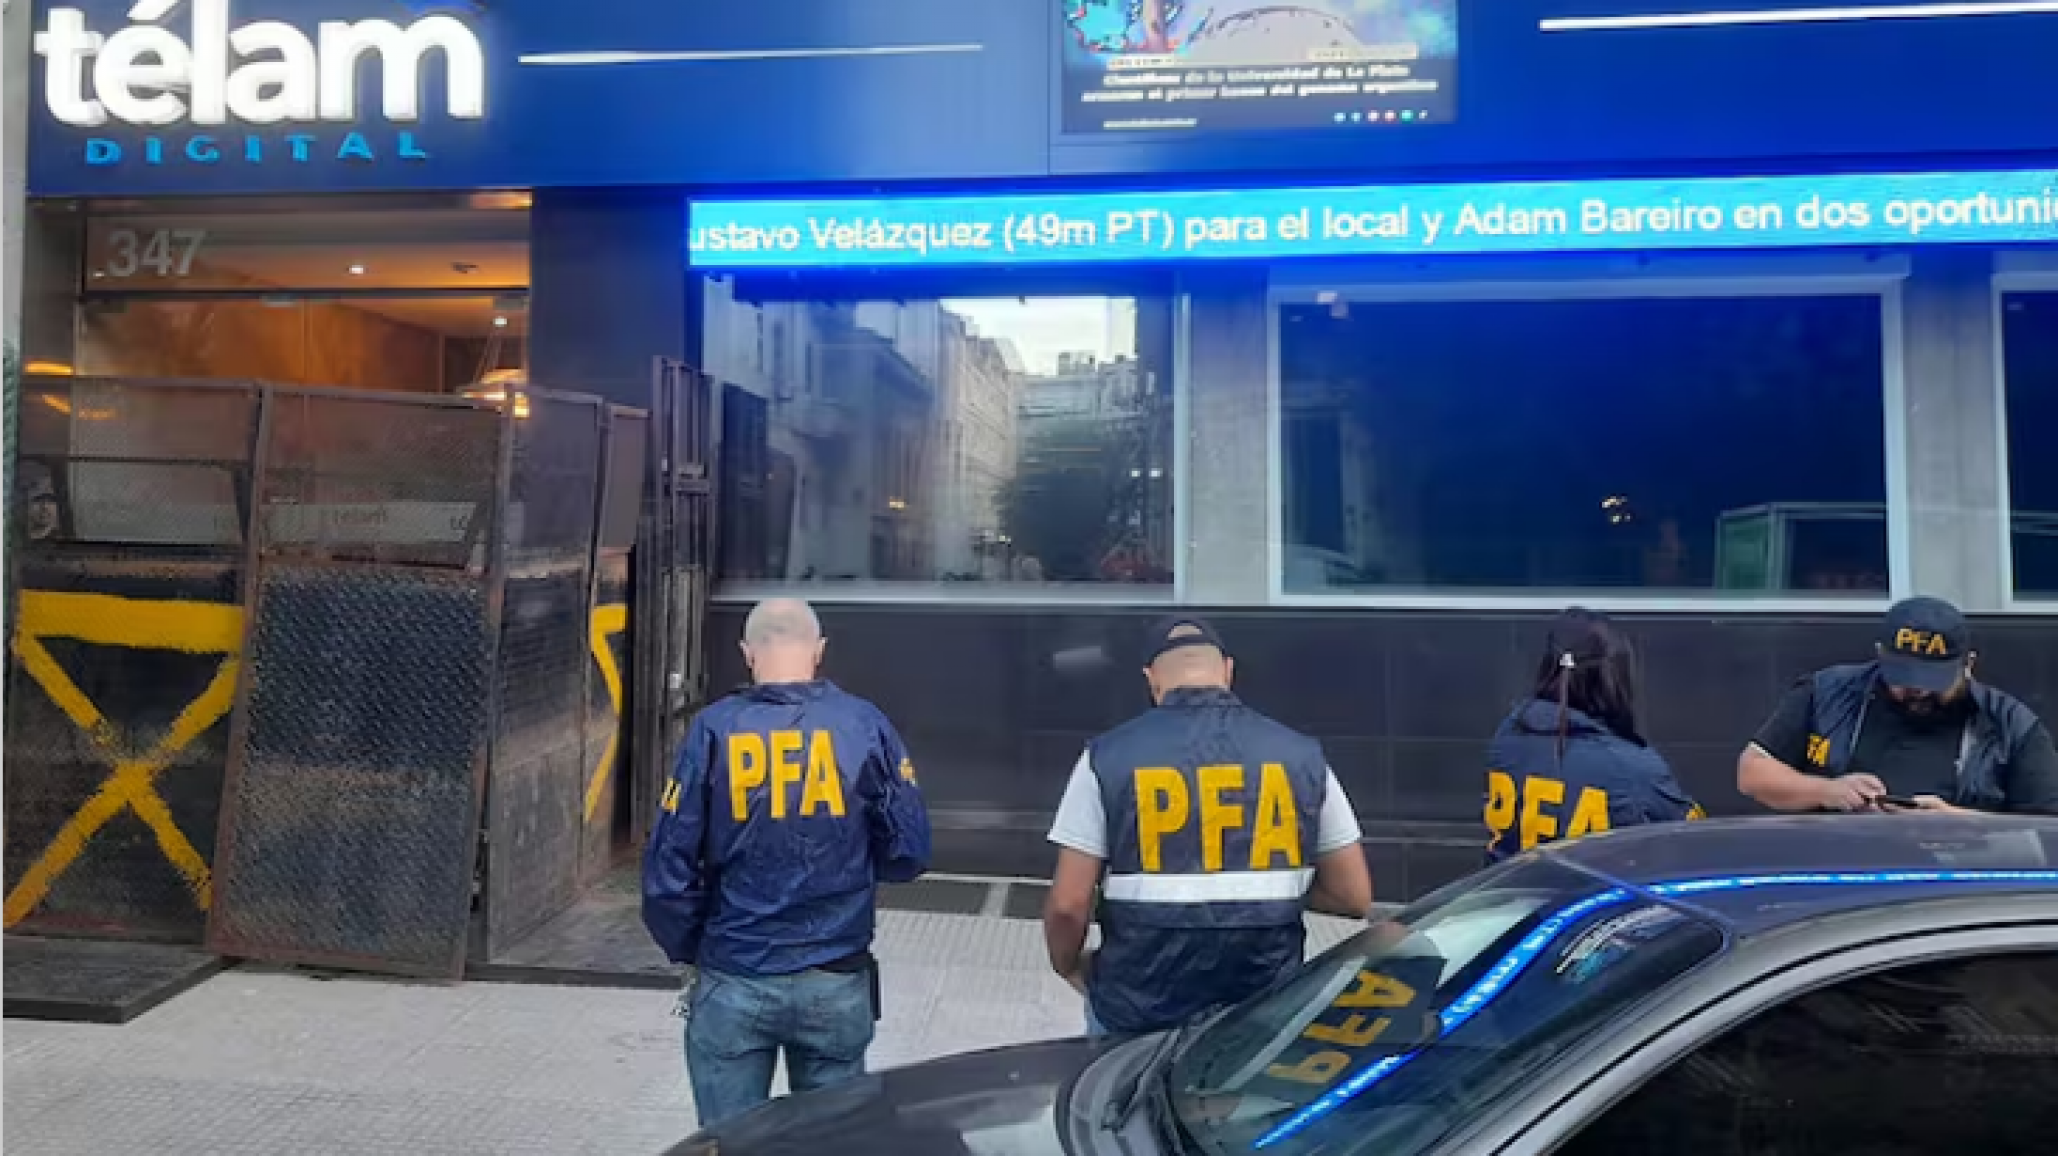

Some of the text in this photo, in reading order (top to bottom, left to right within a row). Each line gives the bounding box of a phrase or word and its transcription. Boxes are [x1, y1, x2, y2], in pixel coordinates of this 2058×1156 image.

[34, 0, 485, 126] télam
[85, 132, 428, 165] DIGITAL
[105, 229, 206, 276] 347
[807, 216, 992, 256] Velázquez
[1003, 211, 1097, 252] (49m
[1106, 207, 1175, 251] PT)
[1184, 214, 1268, 251] para
[1276, 205, 1311, 241] el
[1321, 203, 1409, 238] local
[1421, 210, 1443, 245] y
[1453, 203, 1567, 235] Adam
[1579, 197, 1725, 233] Bareiro
[1733, 203, 1782, 231] en
[1795, 193, 1871, 229] dos
[1885, 186, 2058, 235] oportuni
[1895, 628, 1948, 655] PFA
[728, 729, 846, 822] PFA
[1484, 769, 1609, 851] PFA
[1134, 763, 1301, 872] PFA
